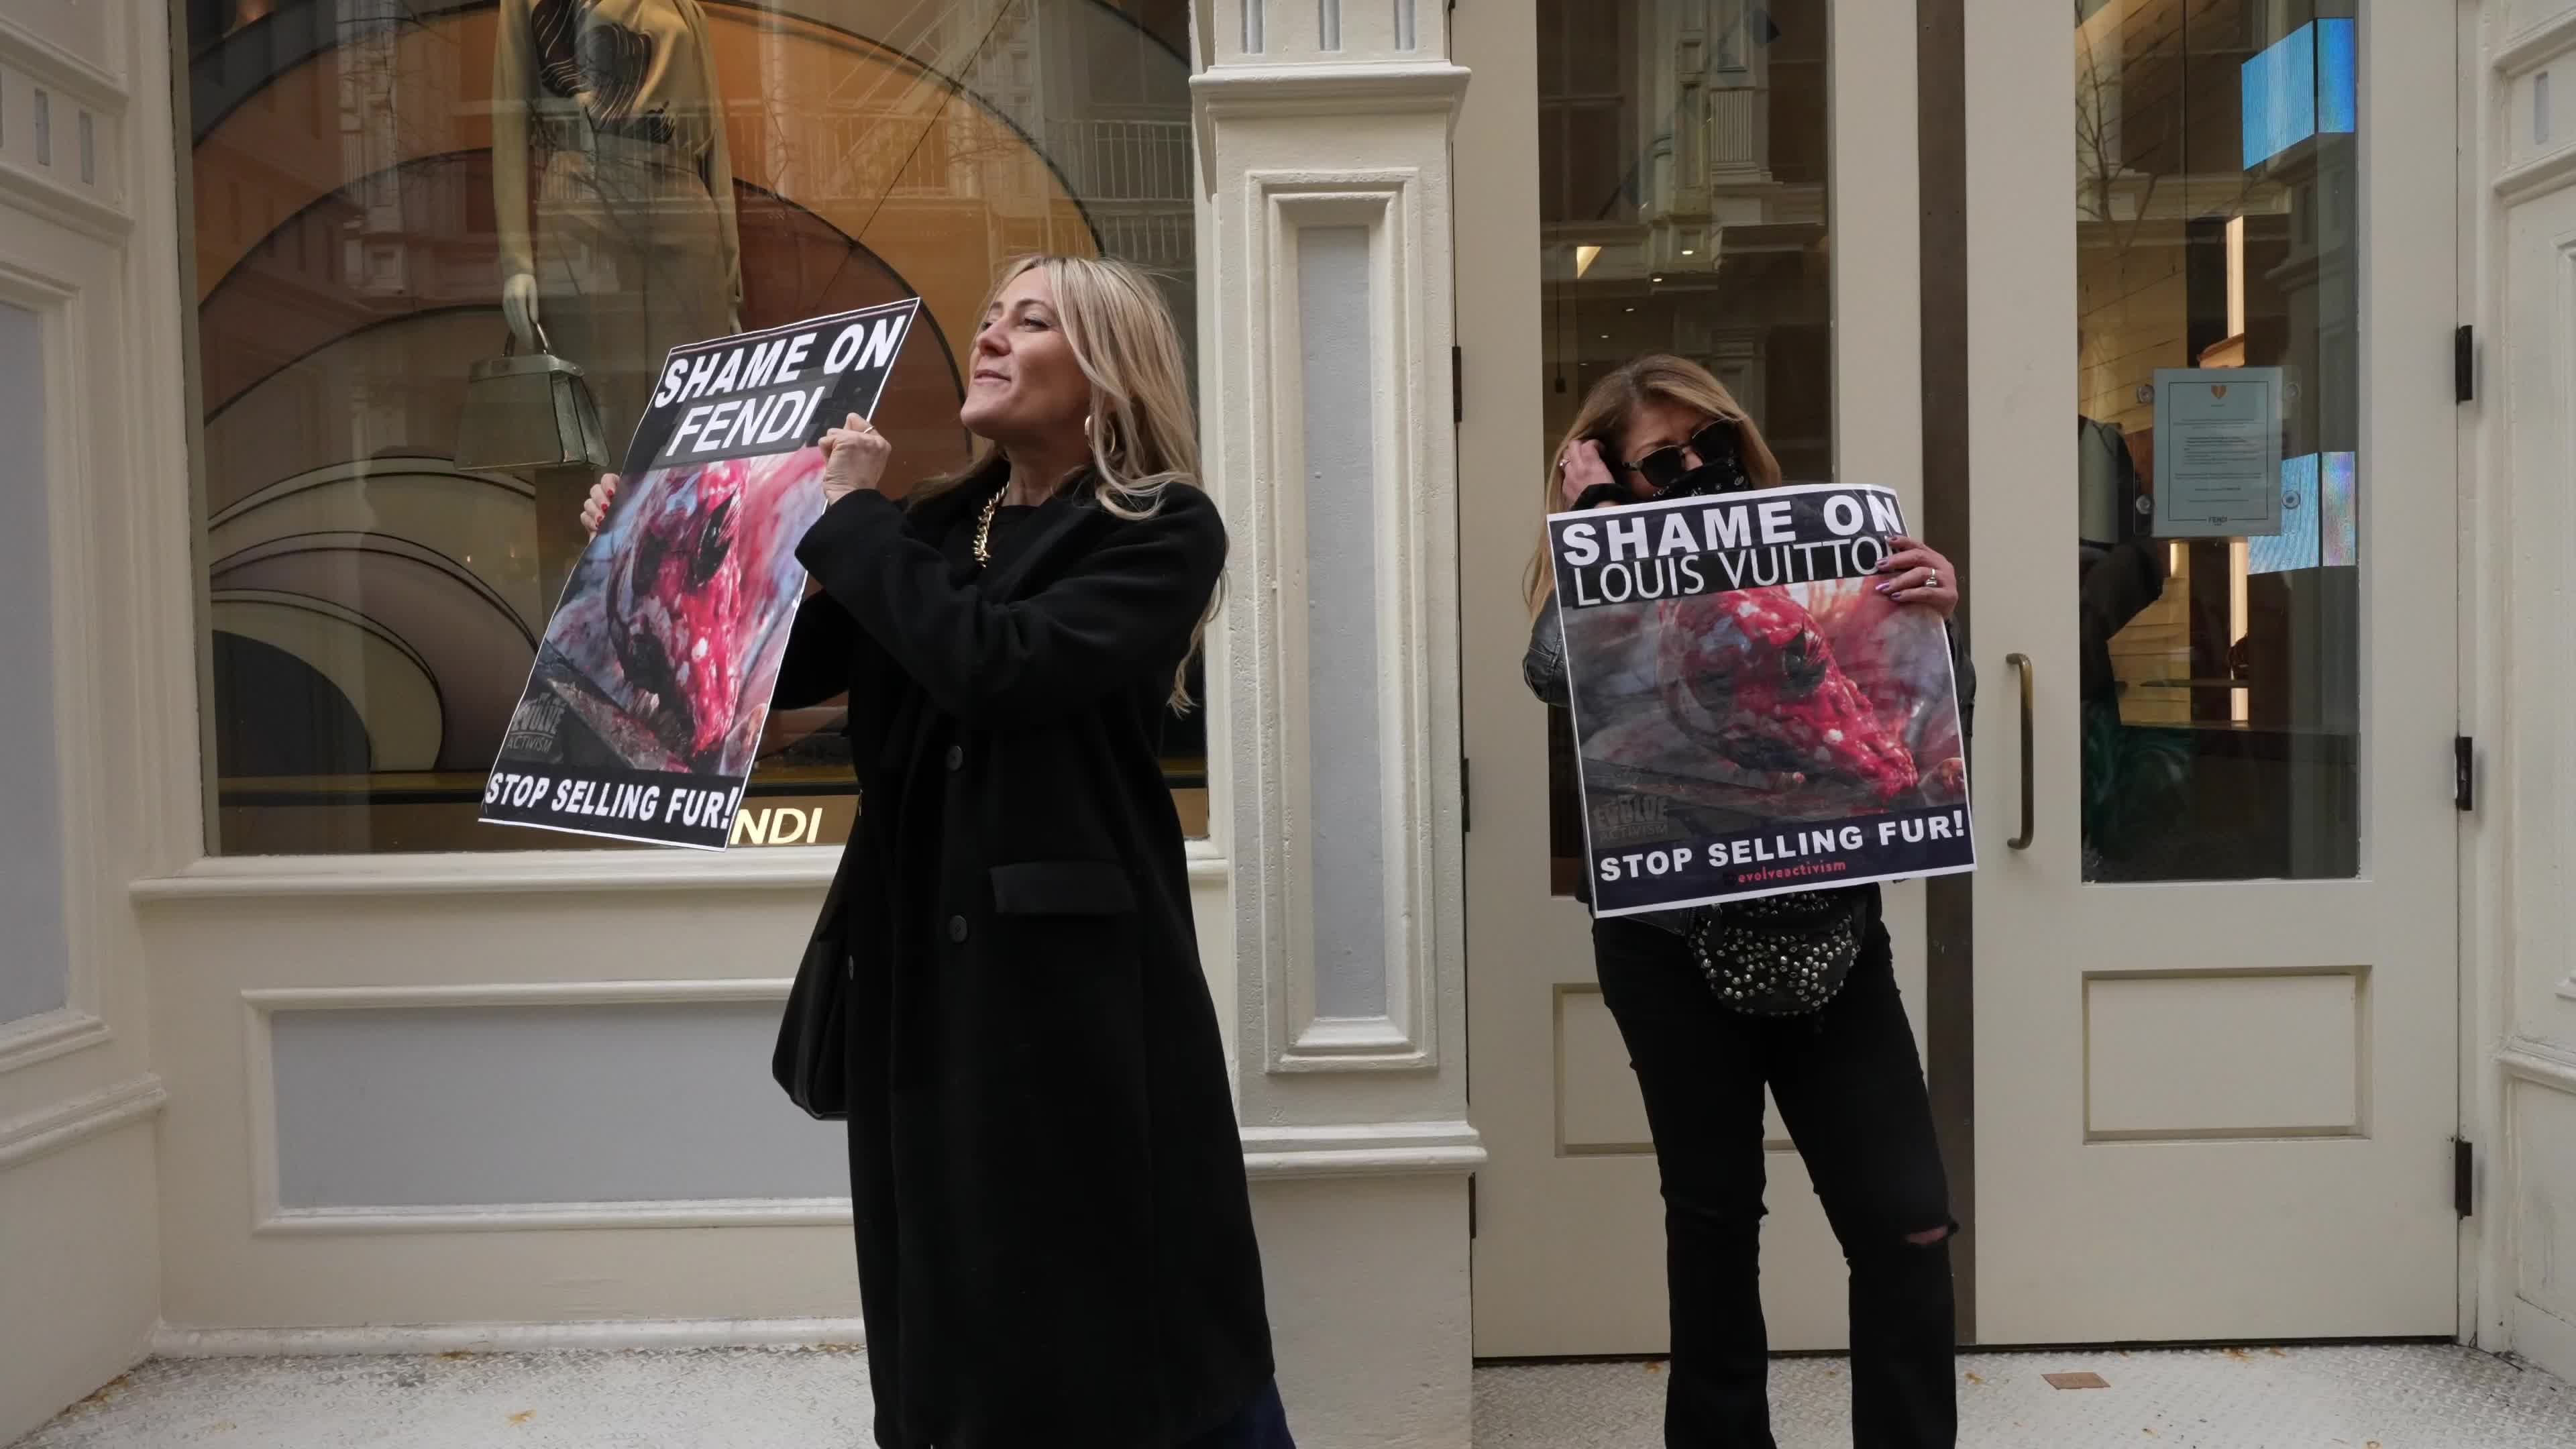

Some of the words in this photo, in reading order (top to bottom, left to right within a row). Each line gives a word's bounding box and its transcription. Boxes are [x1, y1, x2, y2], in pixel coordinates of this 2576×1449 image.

[655, 333, 816, 408] SHAME
[823, 315, 906, 375] ON
[665, 386, 825, 457] FENDI
[1562, 500, 1797, 566] SHAME
[1823, 494, 1902, 536] ON
[1574, 555, 1704, 606] LOUIS
[484, 772, 550, 807] STOP
[551, 779, 659, 821] SELLING
[664, 786, 739, 829] FUR!
[729, 808, 822, 845] NDI
[1600, 848, 1693, 881] STOP
[1709, 826, 1863, 867] SELLING
[1878, 810, 1965, 846] FUR!
[1738, 859, 1846, 883] evolveactivism
